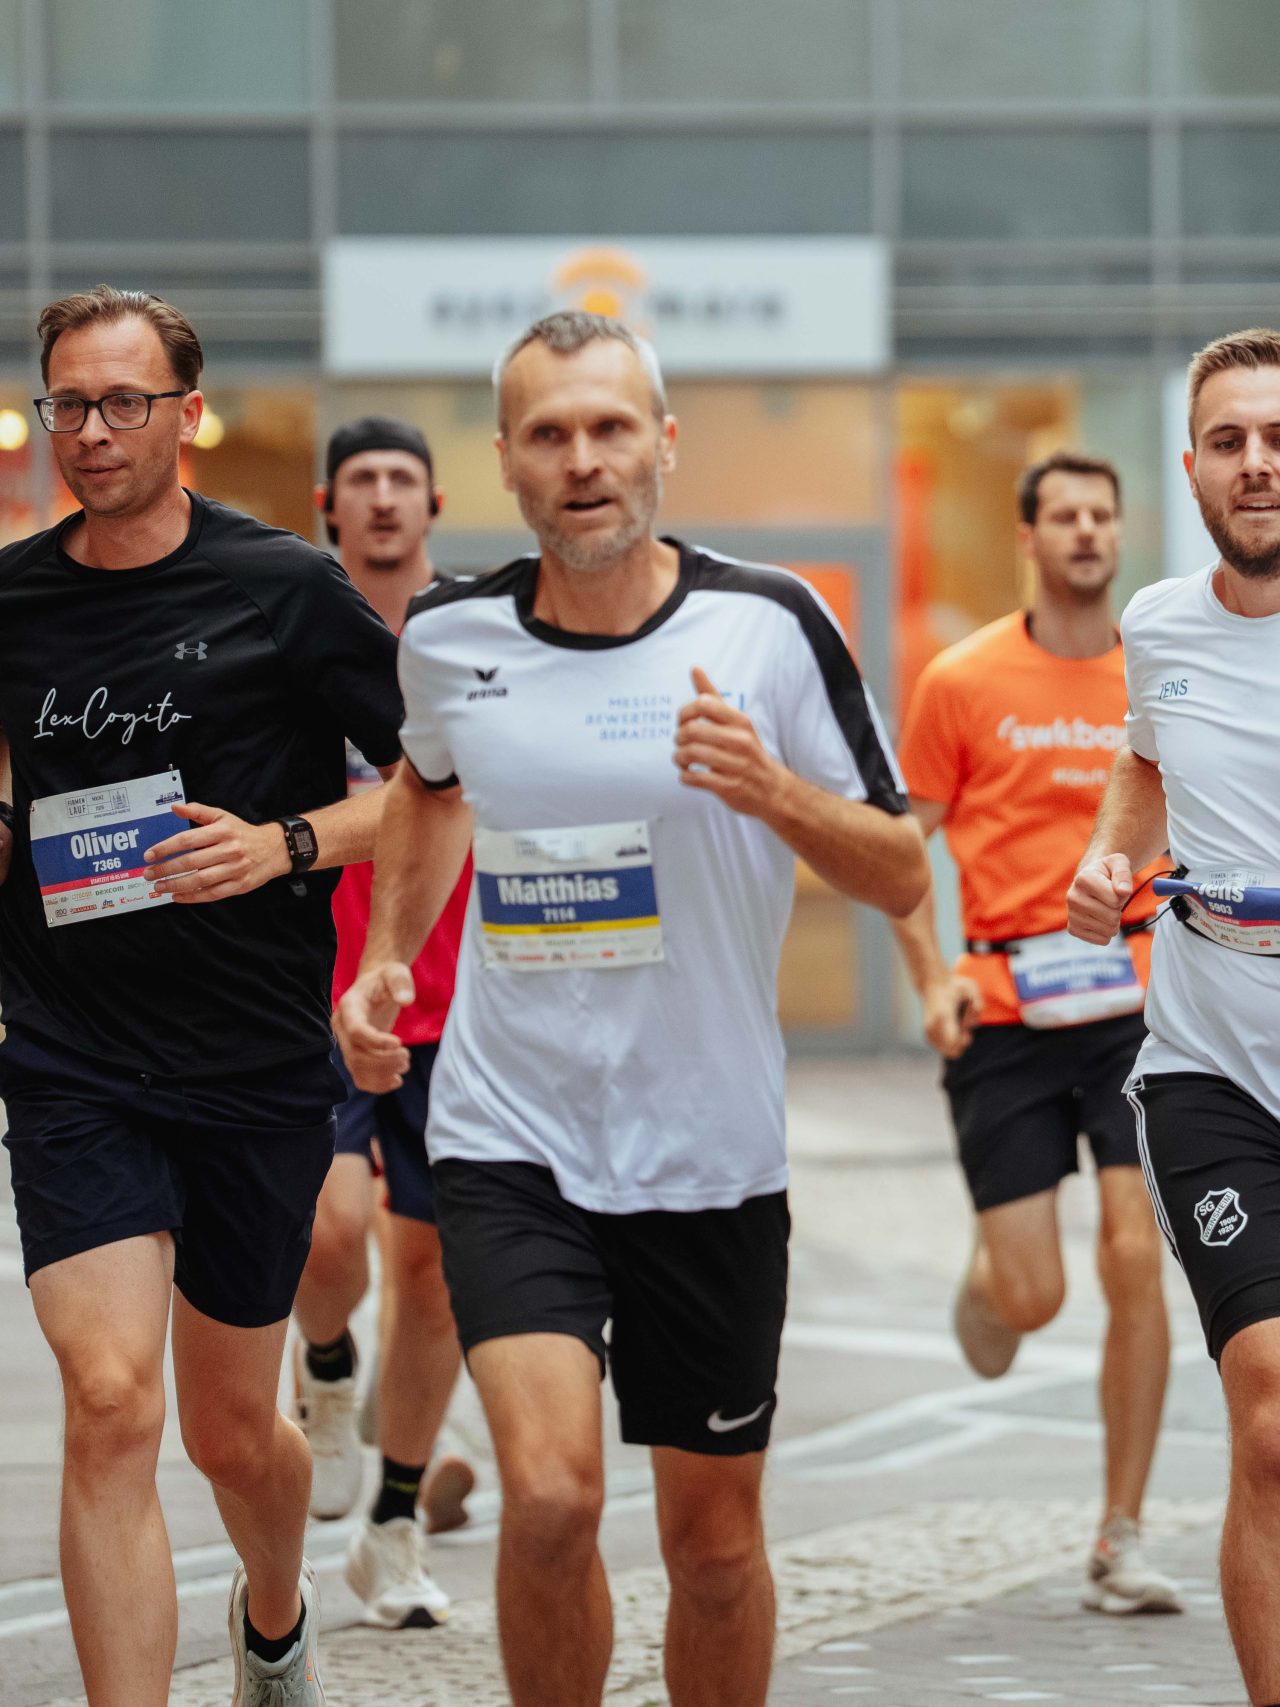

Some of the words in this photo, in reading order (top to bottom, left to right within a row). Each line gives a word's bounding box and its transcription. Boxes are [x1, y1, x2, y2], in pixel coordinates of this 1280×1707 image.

[1158, 678, 1189, 700] JENS
[68, 805, 87, 816] LAUF
[70, 828, 140, 860] Oliver
[92, 857, 122, 873] 7366
[497, 874, 619, 905] Matthias
[1208, 901, 1232, 915] 5903
[1199, 1201, 1215, 1216] SG
